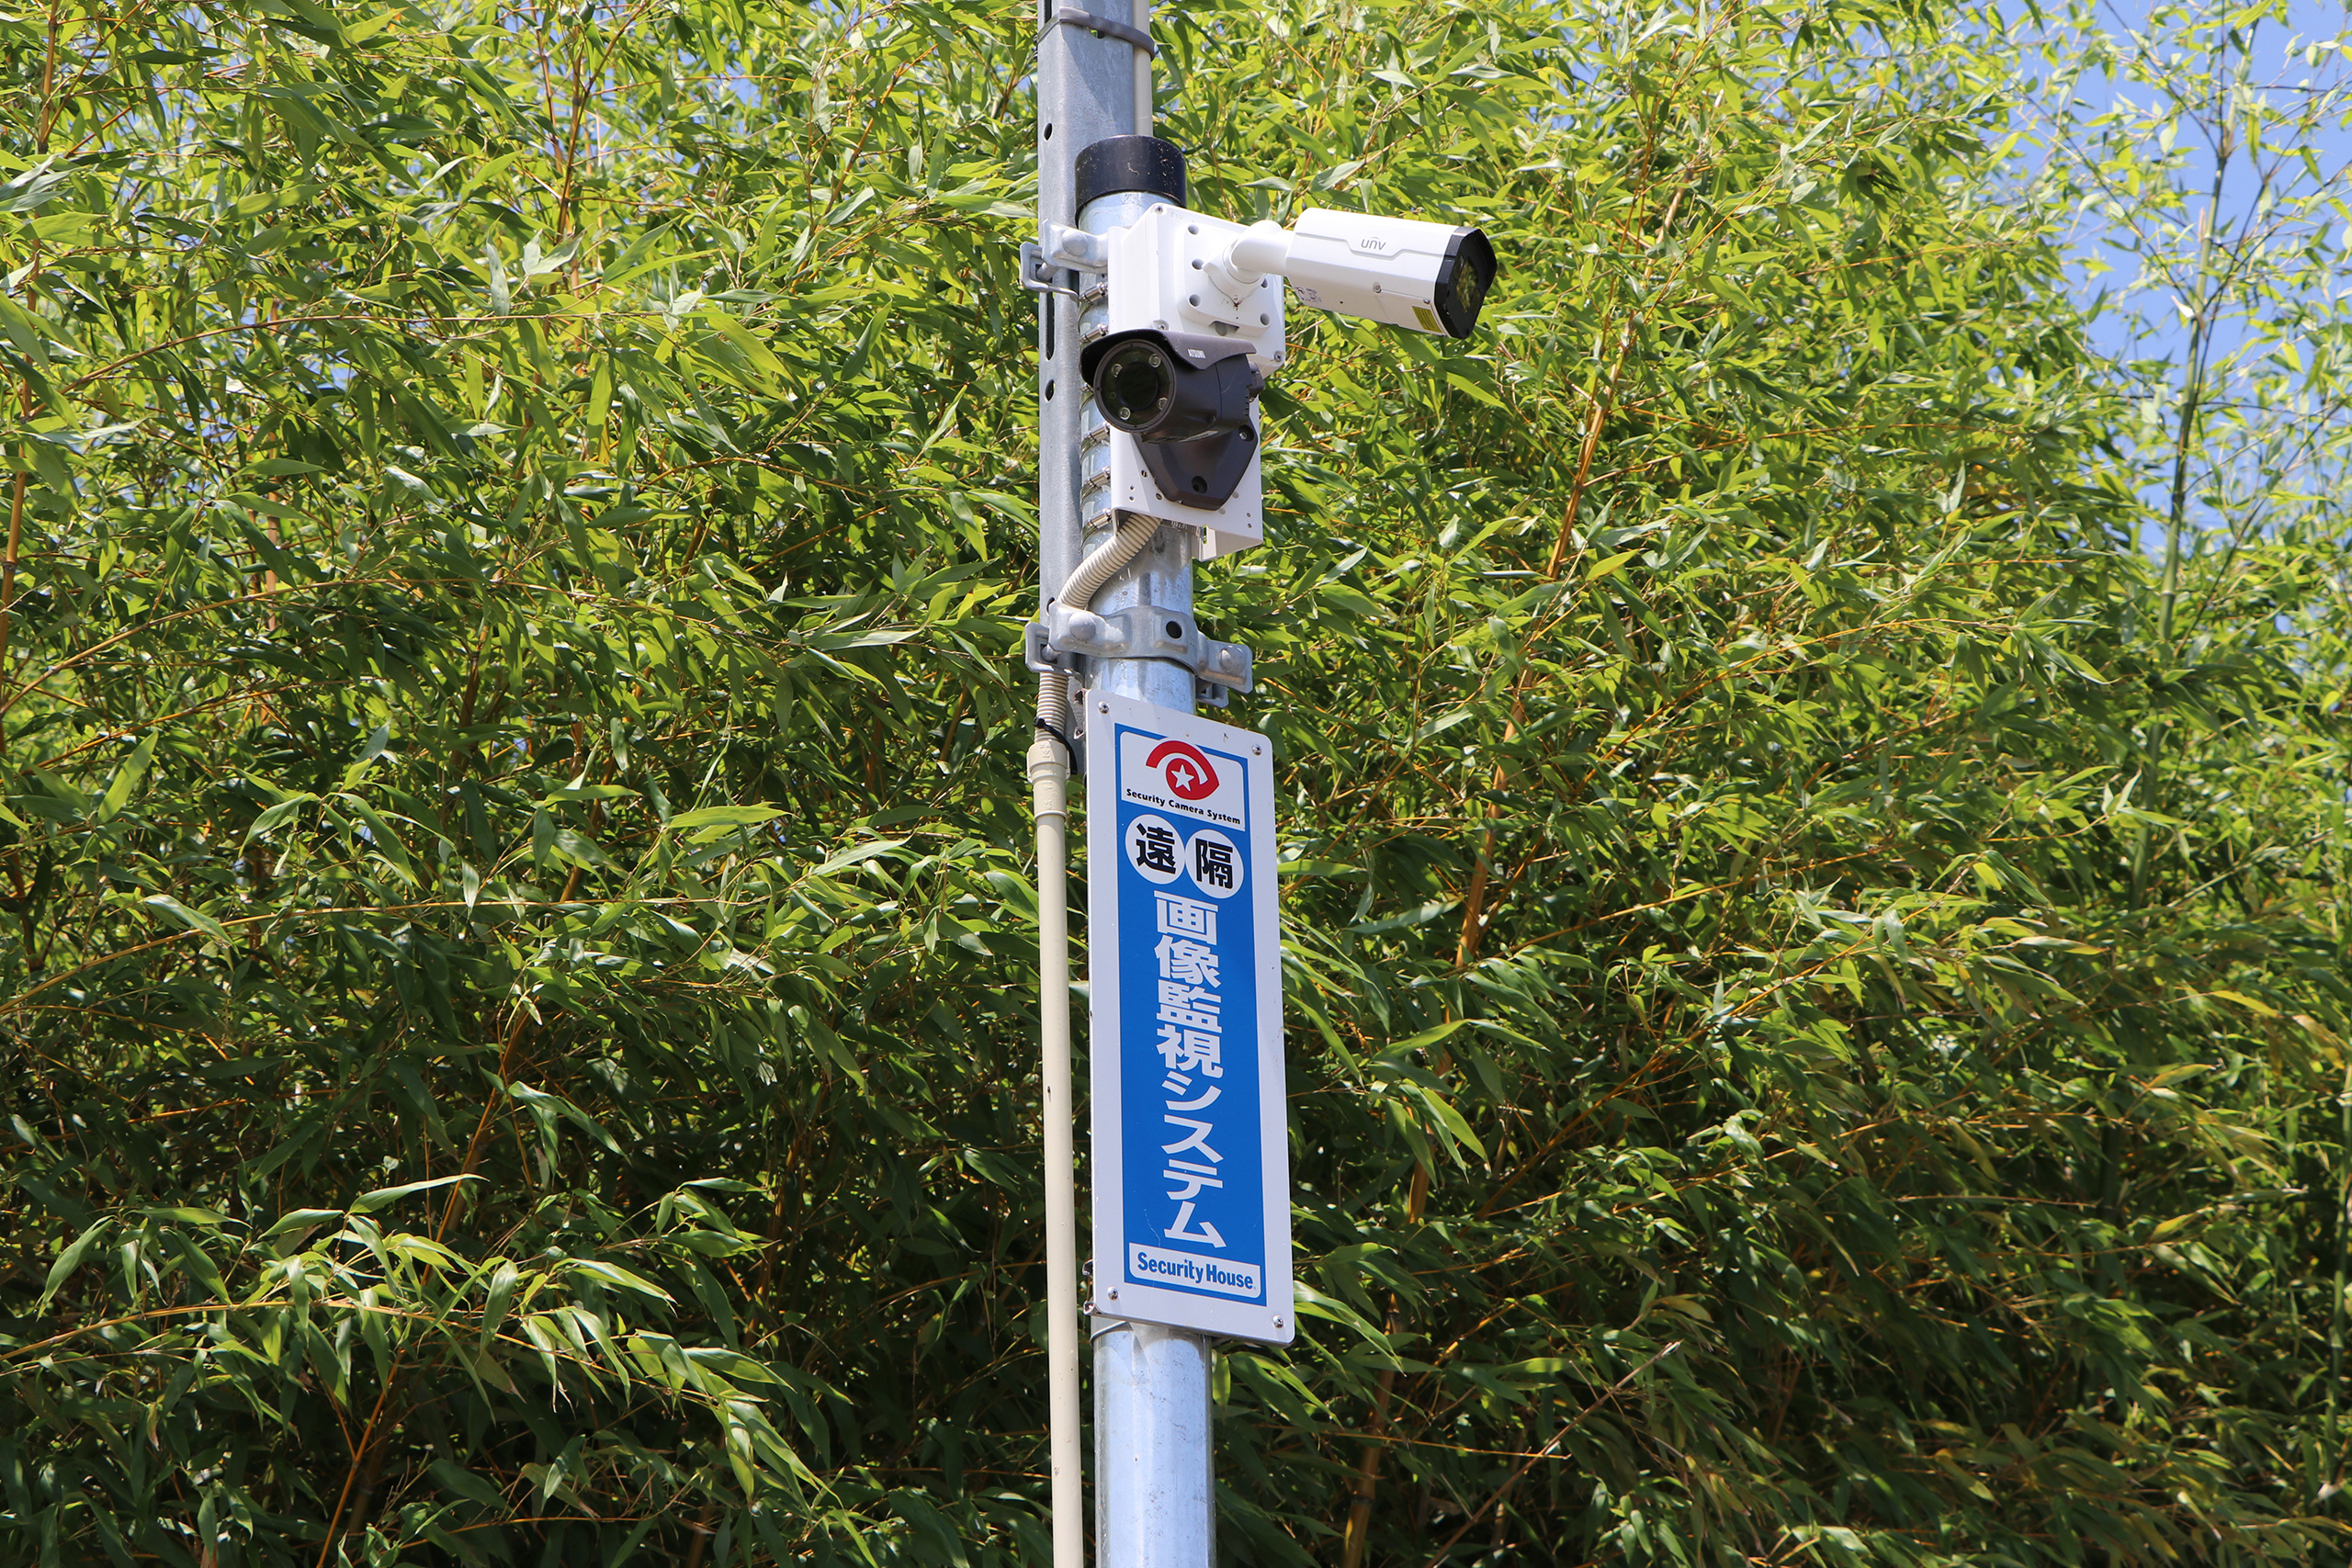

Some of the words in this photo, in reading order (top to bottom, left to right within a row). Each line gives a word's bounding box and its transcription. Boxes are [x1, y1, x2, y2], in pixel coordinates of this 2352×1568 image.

[1126, 788, 1166, 807] Security
[1168, 799, 1204, 816] Camera
[1207, 809, 1241, 825] System
[1136, 822, 1234, 890] 遠隔
[1153, 889, 1227, 1249] 画像監視システム
[1137, 1251, 1204, 1284] Security
[1205, 1263, 1254, 1290] House
